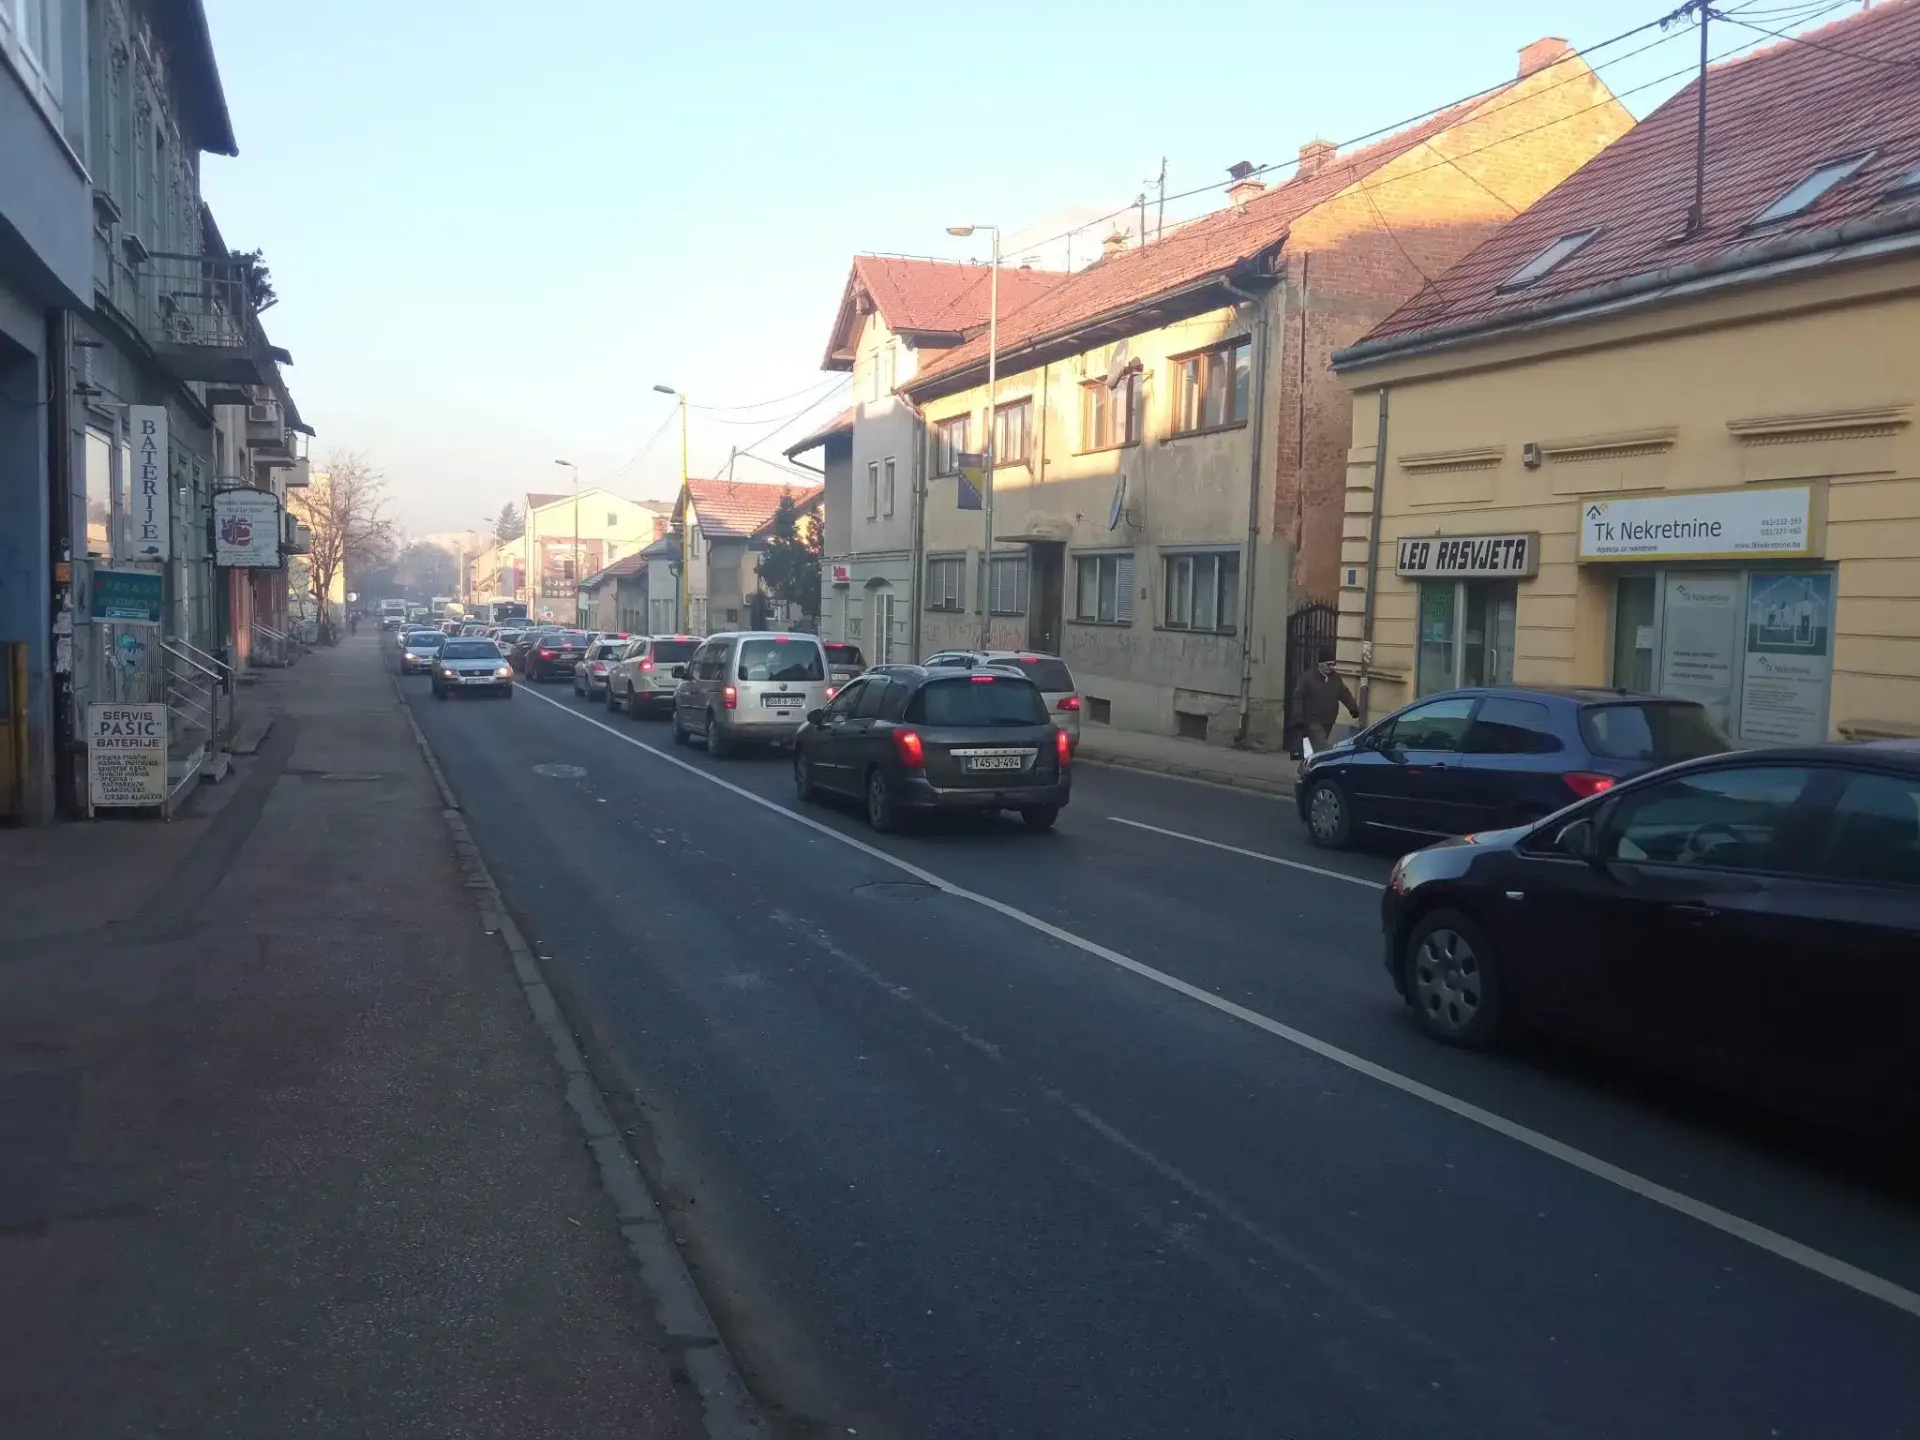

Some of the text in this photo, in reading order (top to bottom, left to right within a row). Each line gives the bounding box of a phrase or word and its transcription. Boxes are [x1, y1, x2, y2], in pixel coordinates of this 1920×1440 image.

[140, 419, 158, 540] BATERIJE
[1594, 517, 1723, 541] Tk Nekretnine
[1399, 539, 1526, 570] LED RASVJETA
[102, 711, 153, 721] SERVIS
[97, 738, 160, 748] BATERIJE
